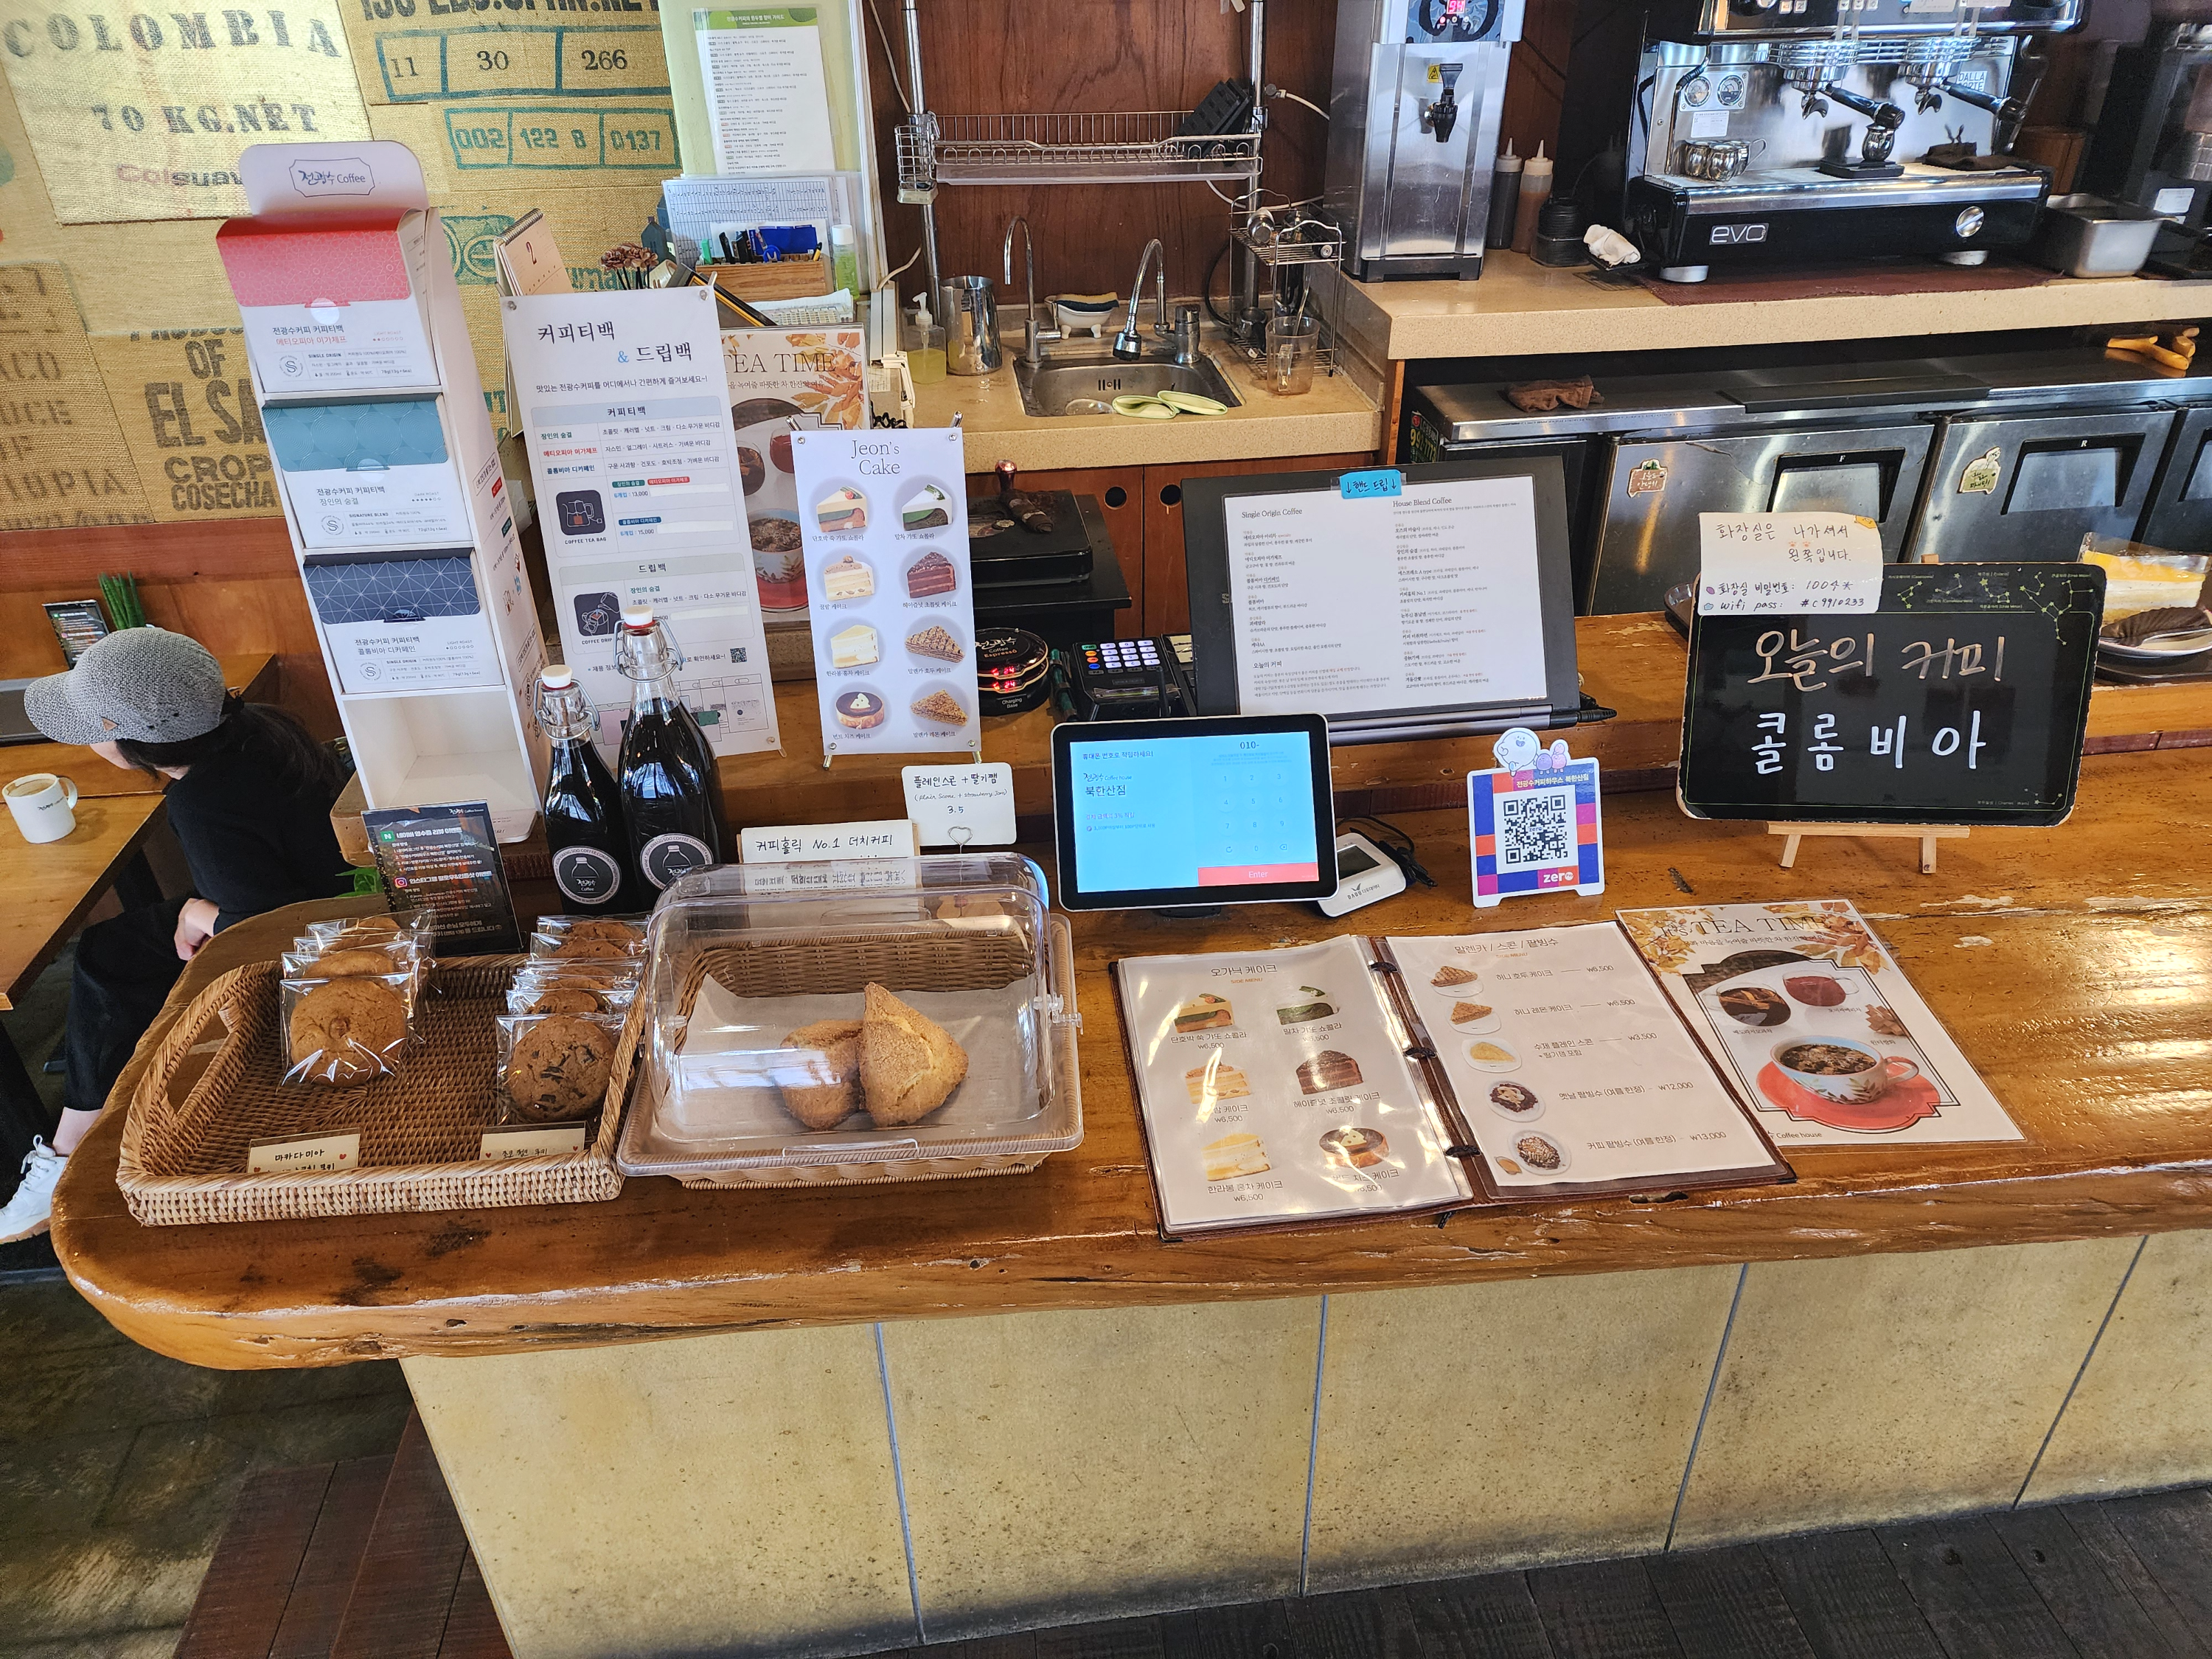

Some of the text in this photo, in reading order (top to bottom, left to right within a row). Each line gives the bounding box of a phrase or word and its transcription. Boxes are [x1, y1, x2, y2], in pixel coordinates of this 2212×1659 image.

[4, 10, 342, 58] COLOMBIA
[476, 50, 509, 71] 30
[580, 49, 628, 72] 266
[392, 57, 420, 78] 11
[1958, 72, 1986, 82] DALLA
[93, 105, 145, 133] 70
[520, 126, 560, 149] 122
[610, 128, 662, 151] 0137
[336, 172, 366, 185] Coffee
[272, 324, 344, 336] 전광수커피 커피티백
[538, 321, 616, 345] 커피티백
[276, 335, 347, 347] 에티오피아 이가체프
[184, 338, 226, 380] OF
[617, 341, 692, 364] & 드립백
[773, 352, 836, 373] TIME
[536, 383, 557, 393] 맛있는
[559, 381, 602, 392] 전광수커피를
[602, 378, 638, 389] 어디에서나
[639, 377, 667, 387] 간편하게
[145, 380, 207, 449] EL
[607, 405, 647, 417] 커피티백
[675, 422, 687, 431] 다소
[540, 431, 559, 440] 장인의
[543, 446, 598, 458] 에티오피아 이가체프
[605, 444, 622, 453] 자스민
[653, 441, 674, 451] 시트러스
[164, 452, 274, 483] CROP
[571, 464, 596, 473] 디카페인
[641, 459, 658, 468] 건포도
[859, 458, 901, 476] Cake
[316, 485, 386, 497] 전광수커피 커피티백
[1352, 477, 1388, 494] 핸드 드립
[170, 481, 279, 512] COSECHA
[631, 490, 649, 498] 13,000
[319, 497, 343, 507] 장인의
[1392, 496, 1453, 508] House Blend Coffee
[1242, 508, 1303, 519] Single Origin Coffee
[637, 528, 655, 536] 15,000
[1715, 521, 1849, 542] 화장실은 나가셔서
[639, 563, 667, 574] 드립백
[630, 585, 647, 594] 장인의
[715, 591, 731, 599] 무거운
[1718, 581, 1748, 597] 화장실
[1720, 599, 1746, 611] wifi
[354, 636, 420, 647] 전광수커피 커피티백
[358, 645, 417, 655] 콜롬비아 디카페인
[1253, 660, 1283, 669] 오늘의 커피
[1747, 627, 2006, 693] 오늘의 커피
[854, 669, 870, 677] 케이크
[1750, 709, 1987, 776] 콜롬비아
[1082, 752, 1102, 760] 휴대폰
[1102, 751, 1120, 759] 번호로
[914, 775, 957, 789] 플레인스콘
[1516, 773, 1590, 788] 전광수커피하우스 북한산점
[1085, 784, 1127, 797] 북한산점
[947, 805, 964, 815] 3.5
[754, 833, 893, 855] 커피홀릭 No.1 더치커피
[1248, 870, 1268, 879] Enter
[1691, 918, 1756, 935] TEA
[1454, 937, 1559, 955] 말렌카 스콘 팥빙수
[1211, 963, 1278, 978] 오가닉 케이크
[1495, 970, 1528, 981] 허니 호두
[1514, 1005, 1548, 1016] 허니 레몬
[1170, 1031, 1248, 1044] 단호박 가또 쇼콜라
[1534, 1037, 1594, 1051] 수제 플레인 스콘
[1577, 1089, 1602, 1099] 팥빙수
[1625, 1085, 1646, 1096] 한정)
[1224, 1103, 1249, 1113] 케이크
[1776, 1130, 1823, 1139] Coffee house
[1587, 1141, 1605, 1150] 커피
[1606, 1138, 1632, 1150] 팥빙수
[1655, 1134, 1677, 1146] 한정)
[274, 1149, 325, 1162] 마카다미아
[1207, 1183, 1235, 1194] 한라봉
